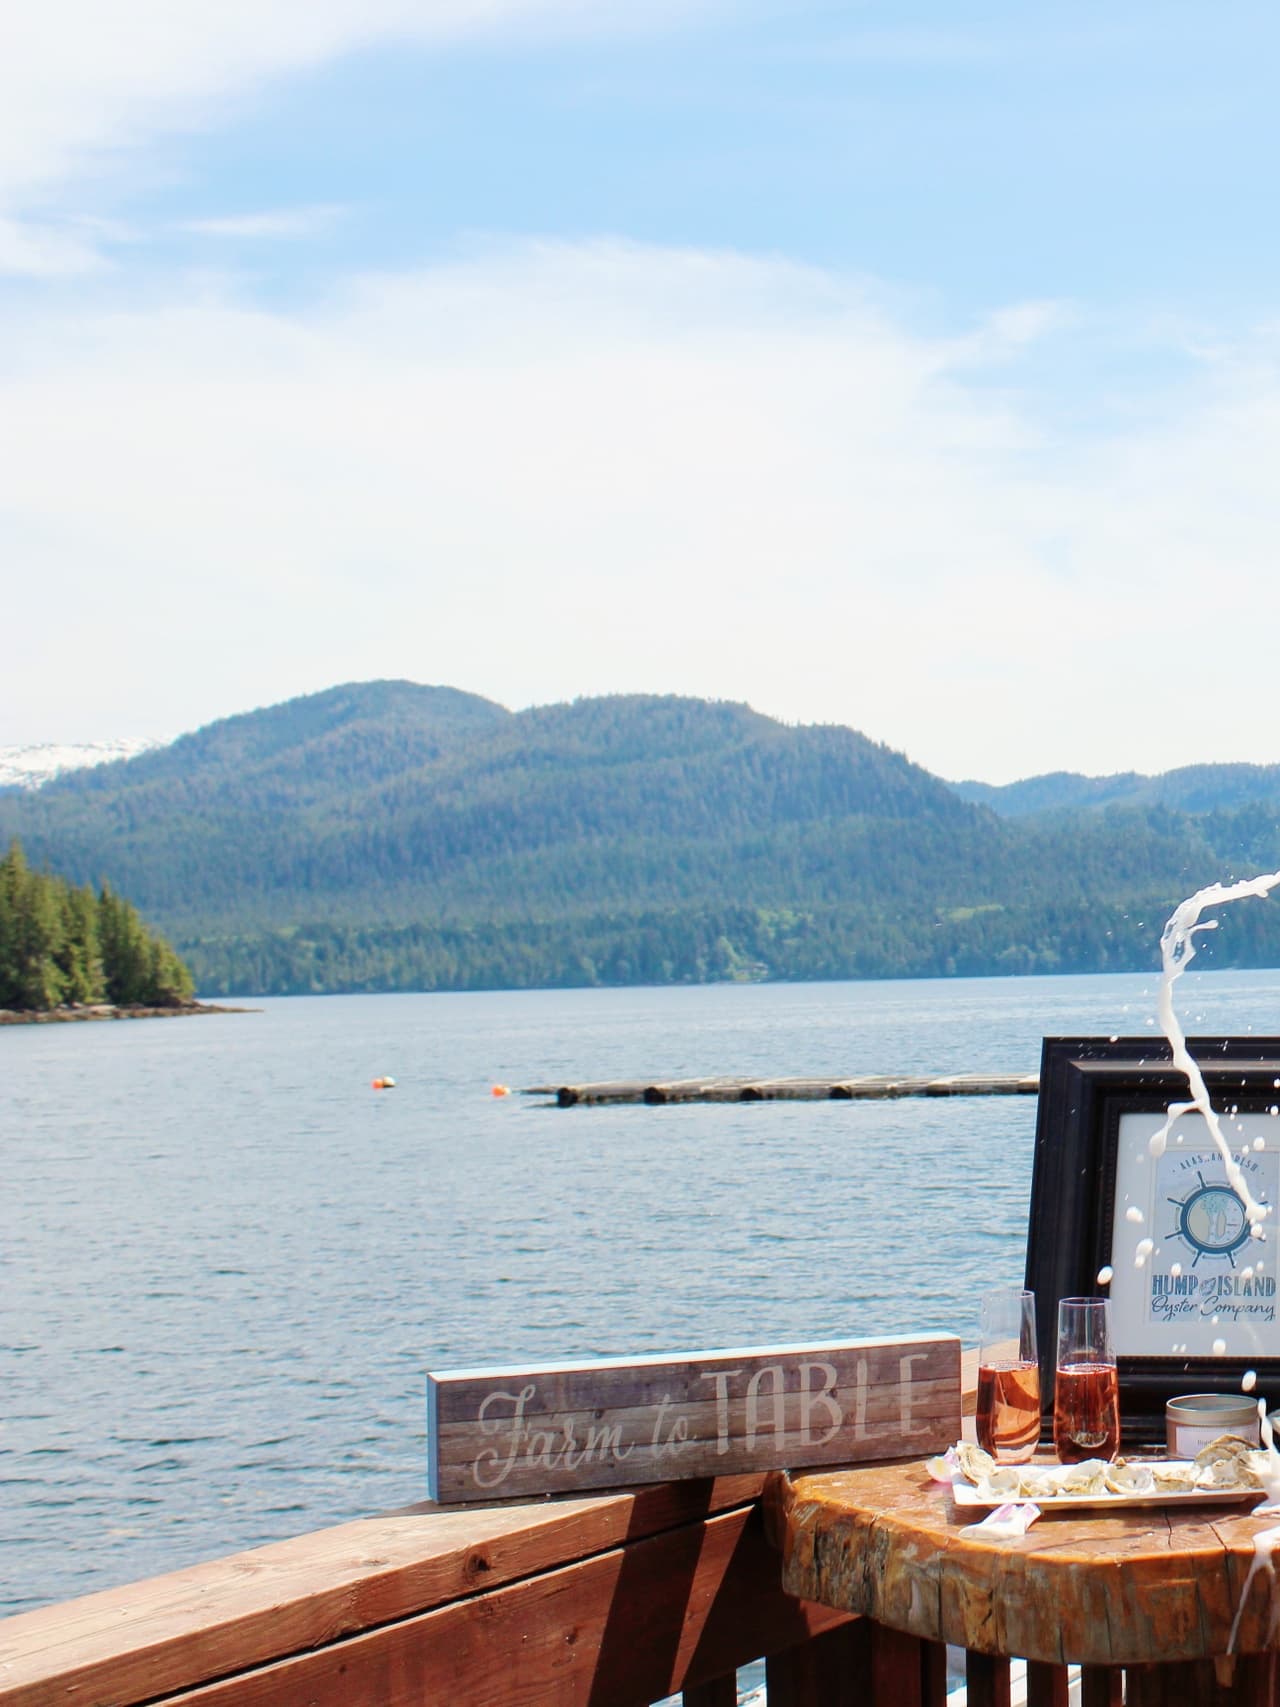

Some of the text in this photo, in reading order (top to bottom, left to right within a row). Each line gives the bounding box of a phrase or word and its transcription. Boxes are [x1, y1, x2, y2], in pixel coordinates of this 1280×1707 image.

[1179, 1152, 1259, 1172] ALASAN RESH
[1152, 1274, 1276, 1297] HUMP ISLAND
[1151, 1294, 1276, 1321] Oyster Company
[472, 1353, 936, 1488] Farm to TABLE
